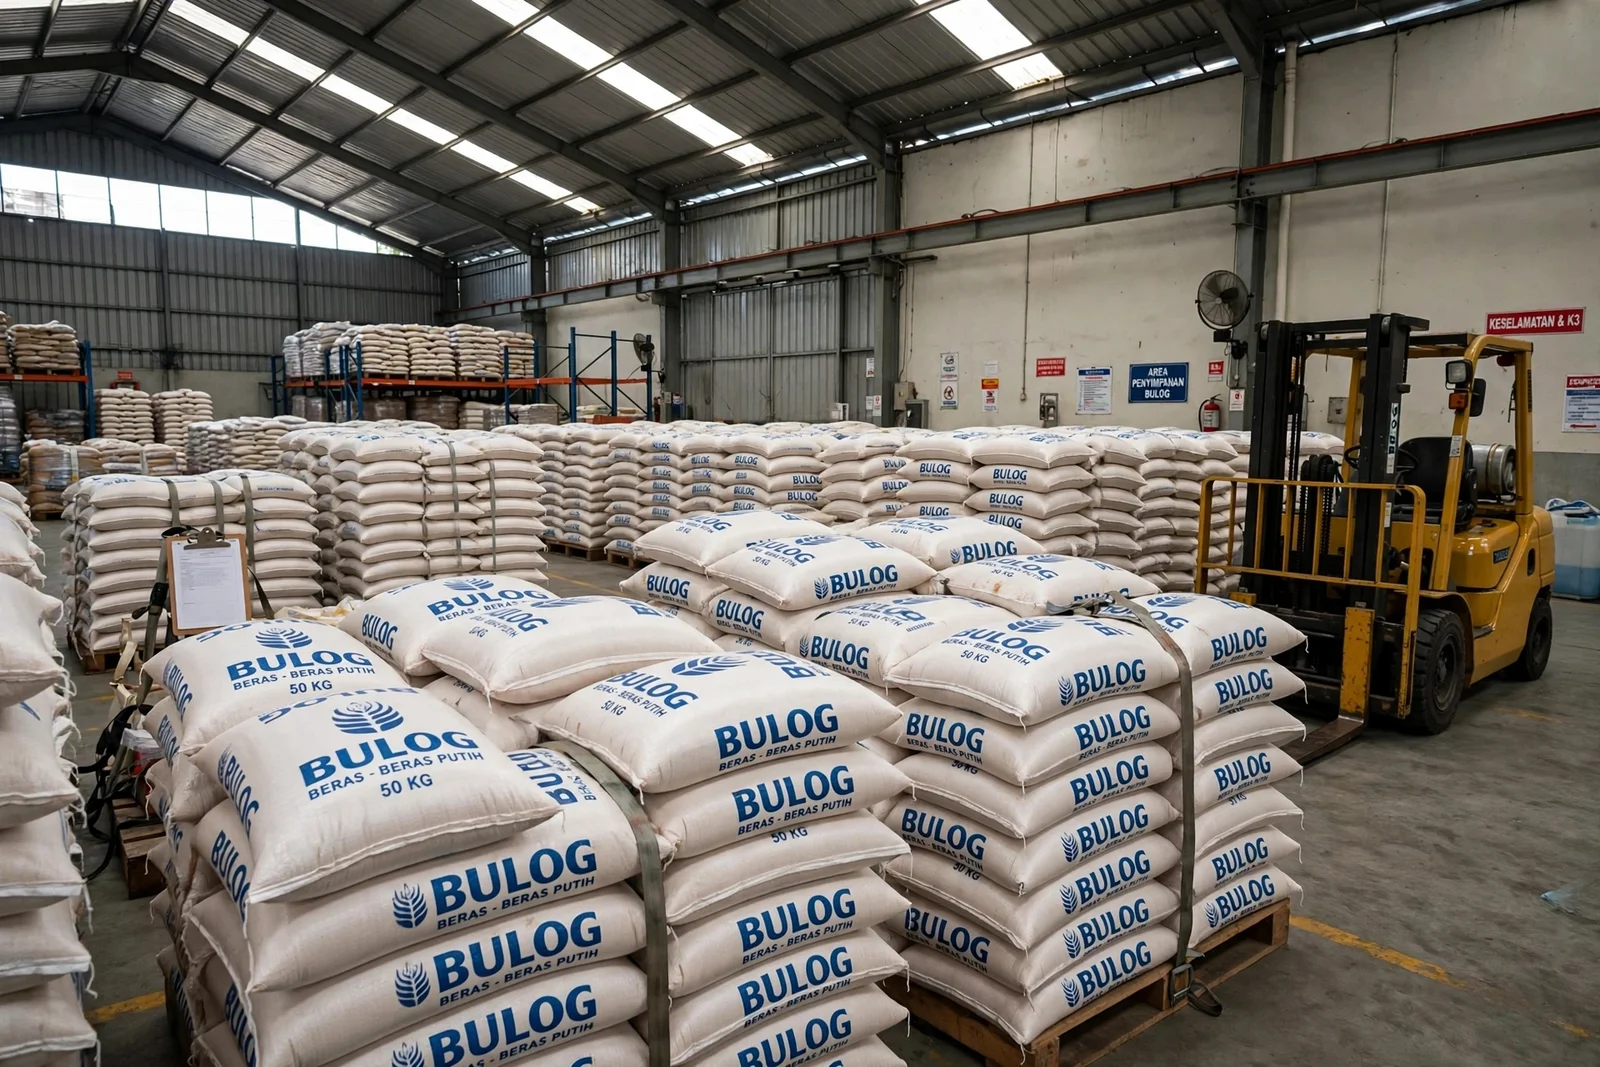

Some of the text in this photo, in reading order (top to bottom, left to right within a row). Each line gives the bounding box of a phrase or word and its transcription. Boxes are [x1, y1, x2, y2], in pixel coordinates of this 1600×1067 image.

[1489, 314, 1580, 329] KESELAMATAN & K3
[1148, 367, 1168, 376] AREA
[1144, 389, 1170, 398] BULOG
[735, 455, 758, 465] BULOG
[919, 463, 951, 474] BULOG
[992, 468, 1028, 481] BULOG
[919, 506, 949, 517] BULOG
[989, 493, 1024, 506] BULOG
[961, 540, 1018, 564] BULOG
[647, 574, 691, 600] BULOG
[829, 564, 898, 595] BULOG
[427, 589, 549, 616] BULOG
[716, 599, 764, 631] BULOG
[361, 613, 398, 651] BULOG
[951, 628, 1051, 661] BULOG
[1211, 626, 1267, 662] BULOG
[226, 649, 373, 682] BULOG
[810, 635, 870, 670] BULOG
[960, 650, 990, 664] 50 KG
[233, 674, 279, 691] BERAS
[290, 667, 334, 679] BERAS
[337, 666, 376, 675] PUTIH
[289, 679, 333, 695] 50 KG
[606, 671, 699, 710] BULOG
[1073, 658, 1146, 699] BULOG
[1215, 668, 1273, 705] BULOG
[601, 700, 627, 716] 50 KG
[640, 699, 667, 718] PUTIH
[714, 703, 839, 760] BULOG
[906, 712, 985, 754] BULOG
[1073, 705, 1151, 751] BULOG
[299, 730, 479, 787] BULOG
[718, 753, 756, 772] BERAS
[765, 741, 802, 758] BERAS
[804, 735, 837, 749] PUTIH
[959, 750, 983, 765] PUTIH
[1078, 745, 1101, 761] BERAS
[1106, 736, 1128, 750] BERAS
[308, 772, 365, 801] BERAS
[379, 756, 433, 776] BERAS
[438, 751, 484, 764] PUTIH
[380, 773, 433, 798] 50 KG
[1070, 754, 1149, 805] BULOG
[1214, 752, 1271, 792] BULOG
[732, 765, 855, 823] BULOG
[737, 818, 775, 836] BERAS
[784, 806, 819, 822] BERAS
[821, 797, 853, 813] PUTIH
[771, 826, 808, 844] 50 KG
[901, 808, 987, 861] BULOG
[1076, 804, 1149, 854] BULOG
[430, 838, 597, 916] BULOG
[965, 867, 981, 881] KG
[1075, 849, 1151, 905] BULOG
[1211, 837, 1268, 881] BULOG
[437, 906, 487, 931] BERAS
[501, 887, 548, 910] BERAS
[553, 876, 595, 895] PUTIH
[1215, 874, 1275, 919] BULOG
[736, 888, 856, 952] BULOG
[904, 907, 991, 964] BULOG
[1077, 898, 1149, 950] BULOG
[433, 911, 602, 993] BULOG
[742, 943, 777, 965] BERAS
[787, 929, 821, 947] BERAS
[823, 920, 853, 936] PUTIH
[439, 981, 491, 1007] BERAS
[504, 961, 552, 983] BERAS
[556, 949, 599, 968] PUTIH
[737, 946, 853, 1017] BULOG
[1077, 940, 1152, 999] BULOG
[428, 984, 597, 1067] BULOG
[744, 1006, 778, 1029] BERAS
[786, 989, 820, 1008] BERAS
[499, 1021, 594, 1060] BERAS PUTIH
[737, 1008, 852, 1067] BULOG
